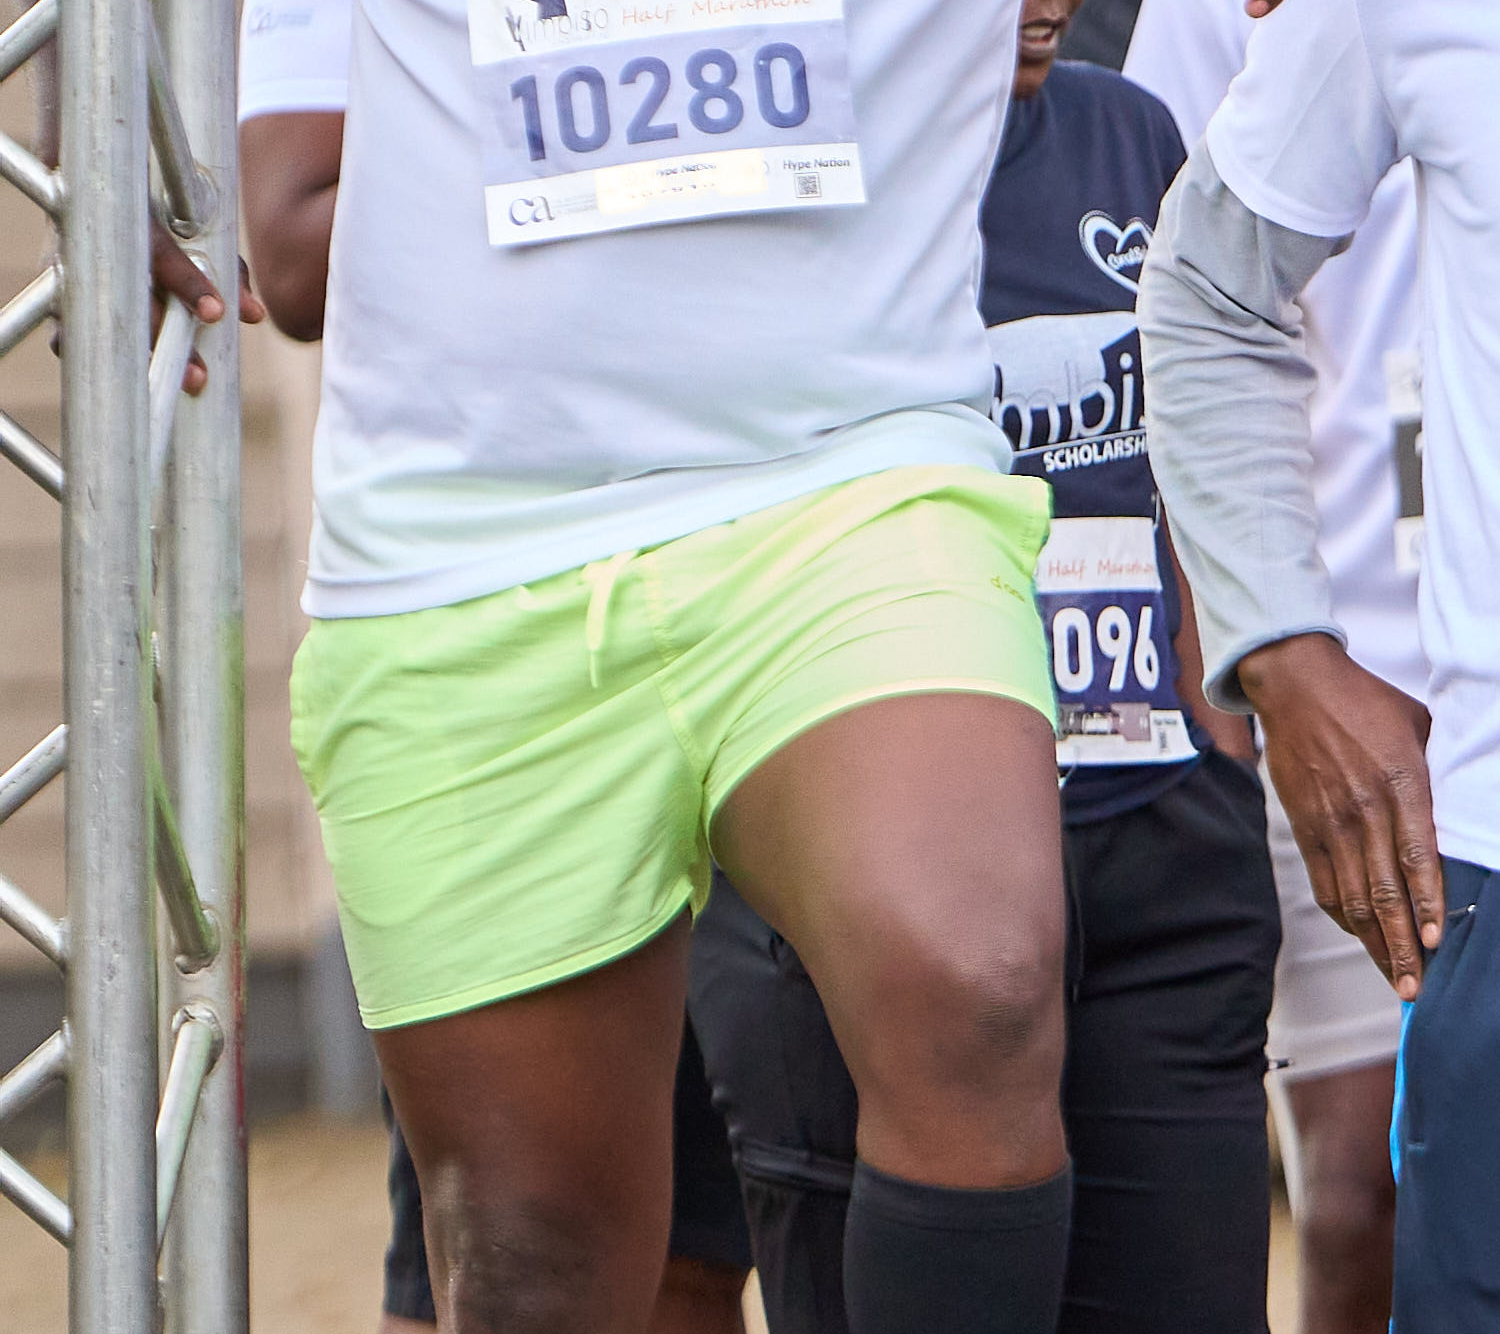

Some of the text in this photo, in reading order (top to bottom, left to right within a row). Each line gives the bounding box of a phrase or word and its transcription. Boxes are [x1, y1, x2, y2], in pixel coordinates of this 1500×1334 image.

[622, 2, 678, 27] Half
[510, 42, 811, 161] 10280
[782, 156, 850, 172] Hype Nation
[508, 195, 555, 226] ca
[1048, 559, 1088, 579] Half
